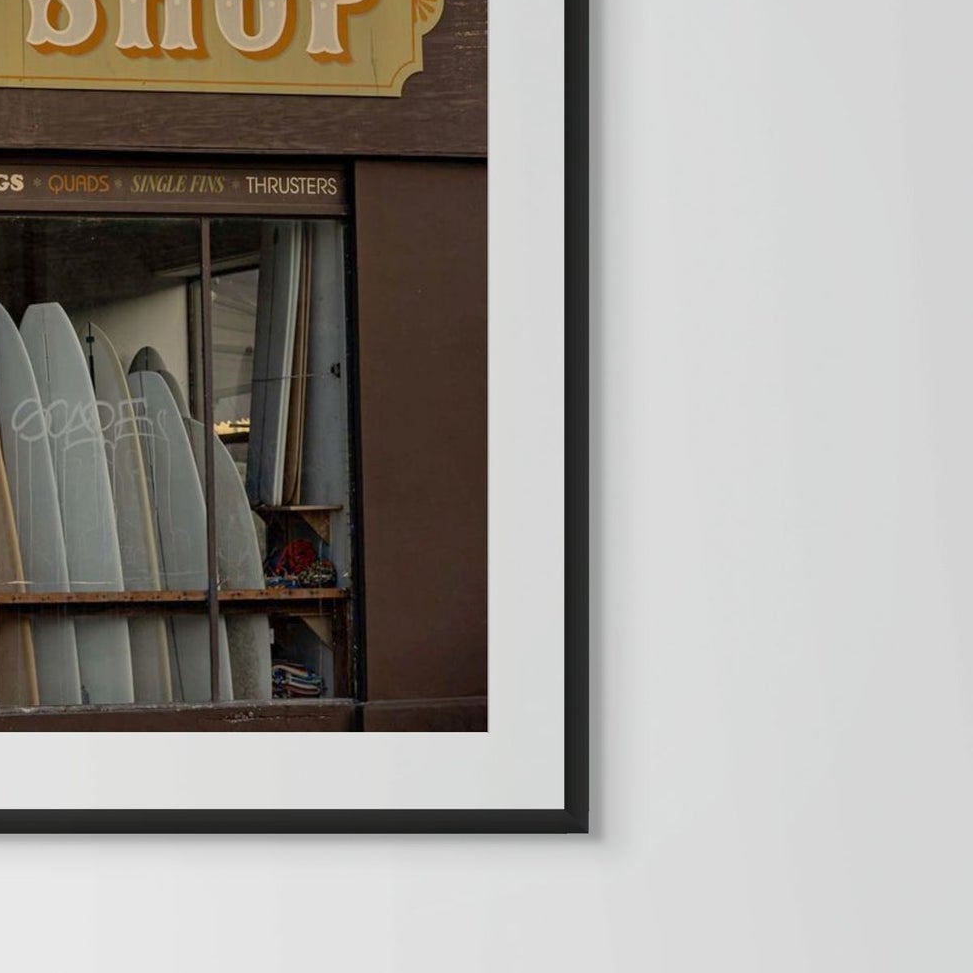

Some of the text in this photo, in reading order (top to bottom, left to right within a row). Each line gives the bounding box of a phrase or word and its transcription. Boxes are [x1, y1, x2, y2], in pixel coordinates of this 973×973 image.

[48, 174, 110, 195] QUADS
[130, 174, 188, 193] SINGLE
[190, 175, 226, 194] FINS
[245, 176, 338, 195] THRUSTERS
